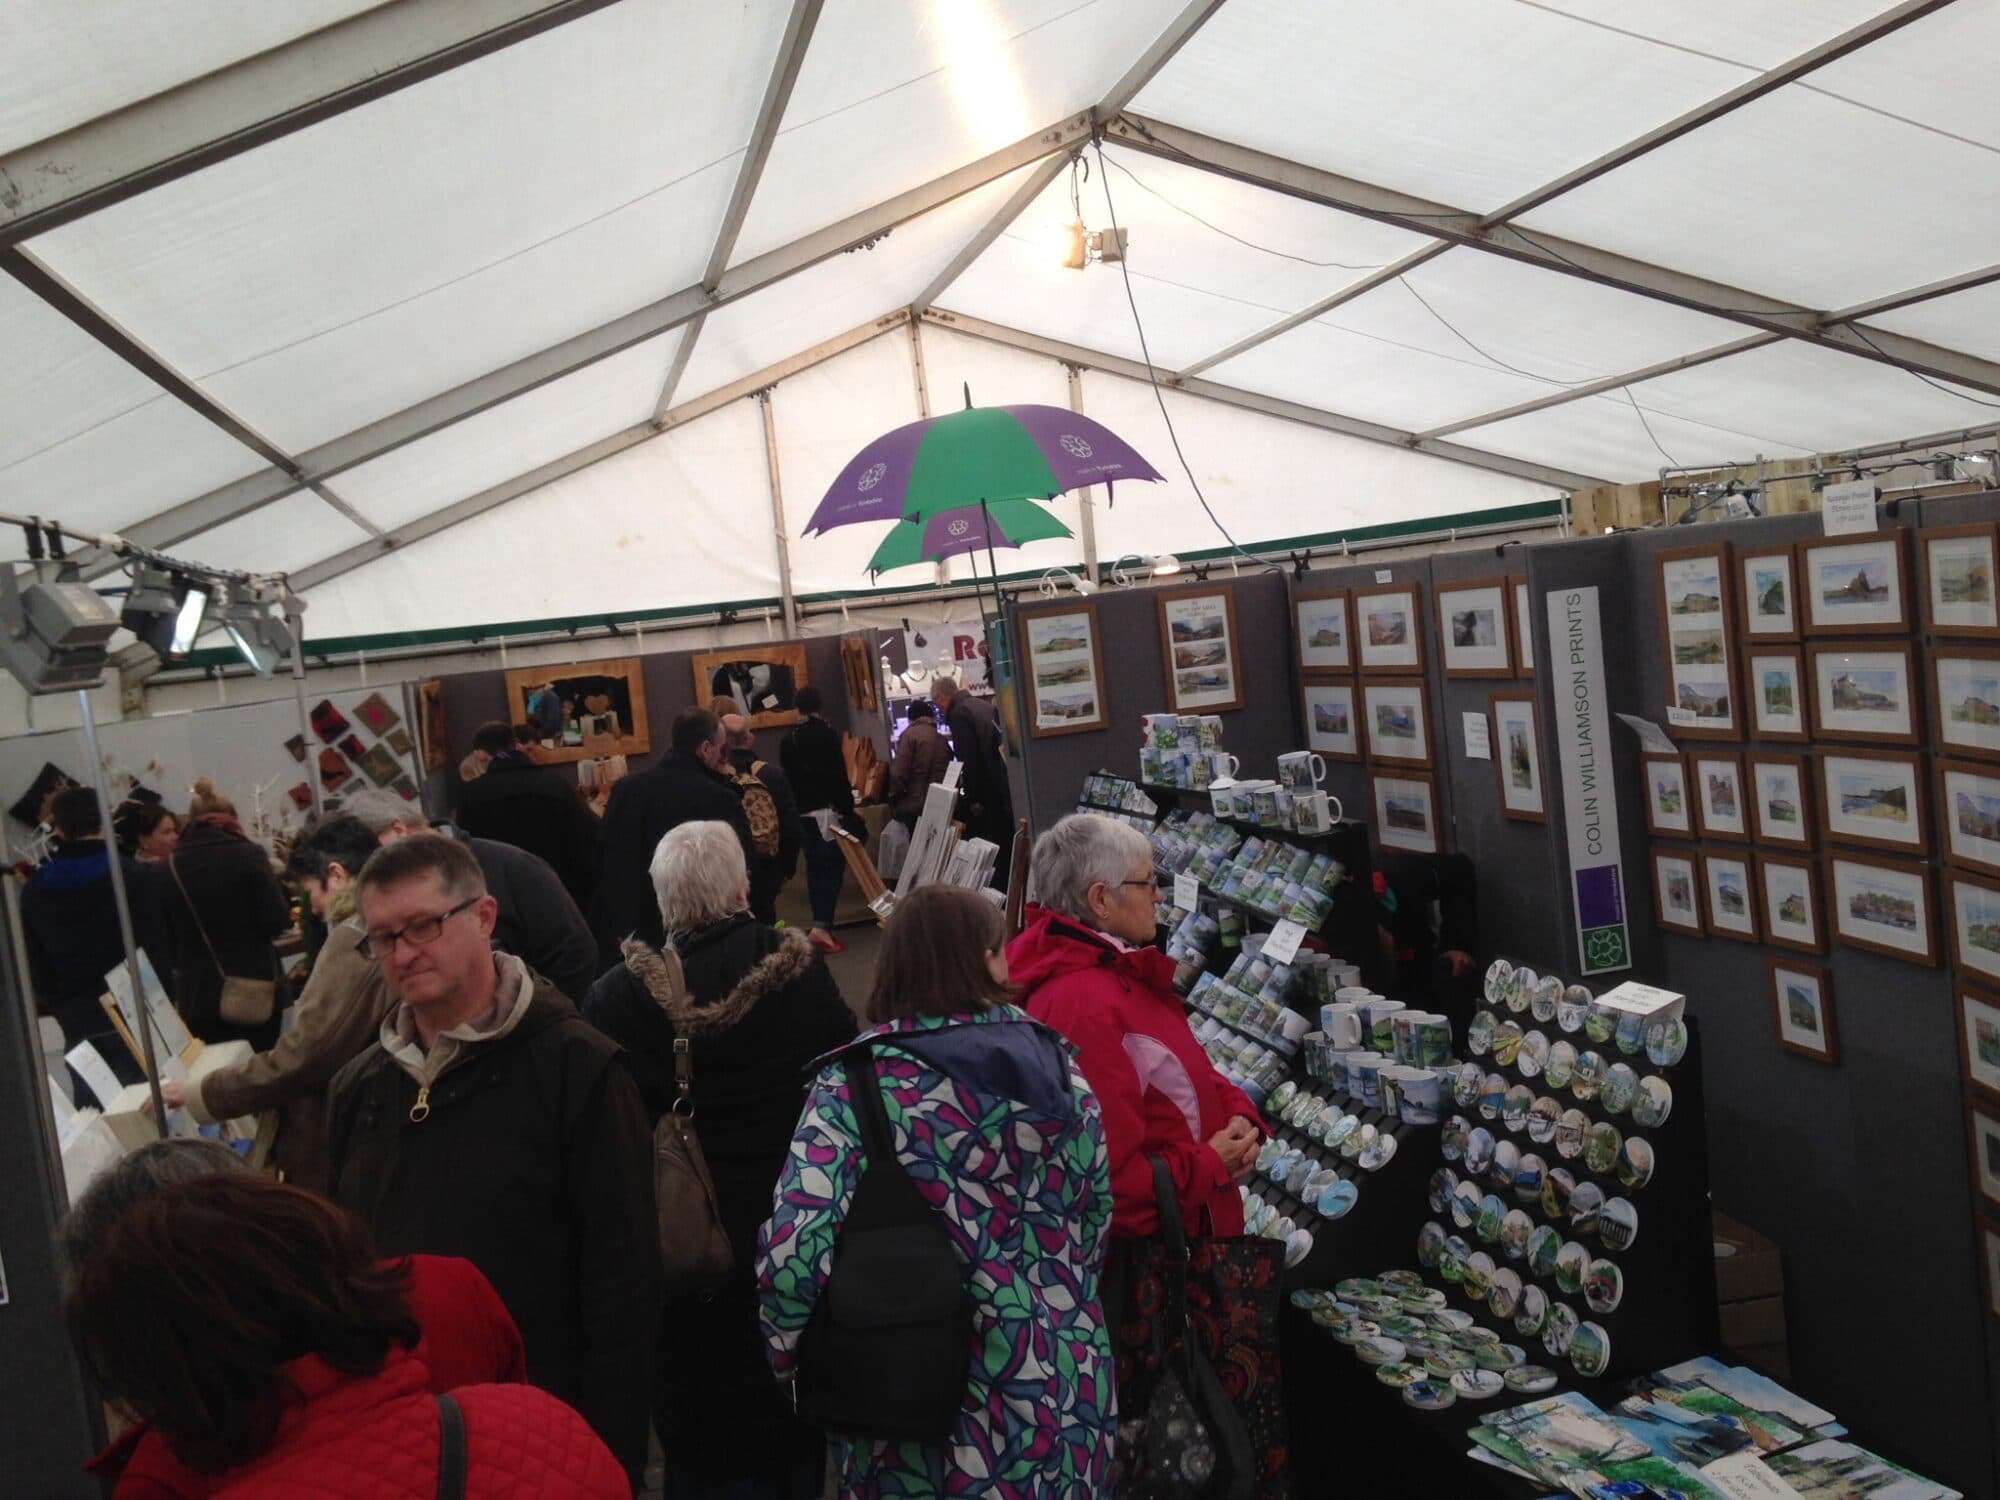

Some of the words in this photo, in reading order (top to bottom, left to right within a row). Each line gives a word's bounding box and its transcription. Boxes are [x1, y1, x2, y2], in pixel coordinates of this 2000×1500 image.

[1566, 592, 1585, 665] PRINTS
[1572, 671, 1597, 793] WILLIAMSON
[1583, 797, 1602, 856] COLIN
